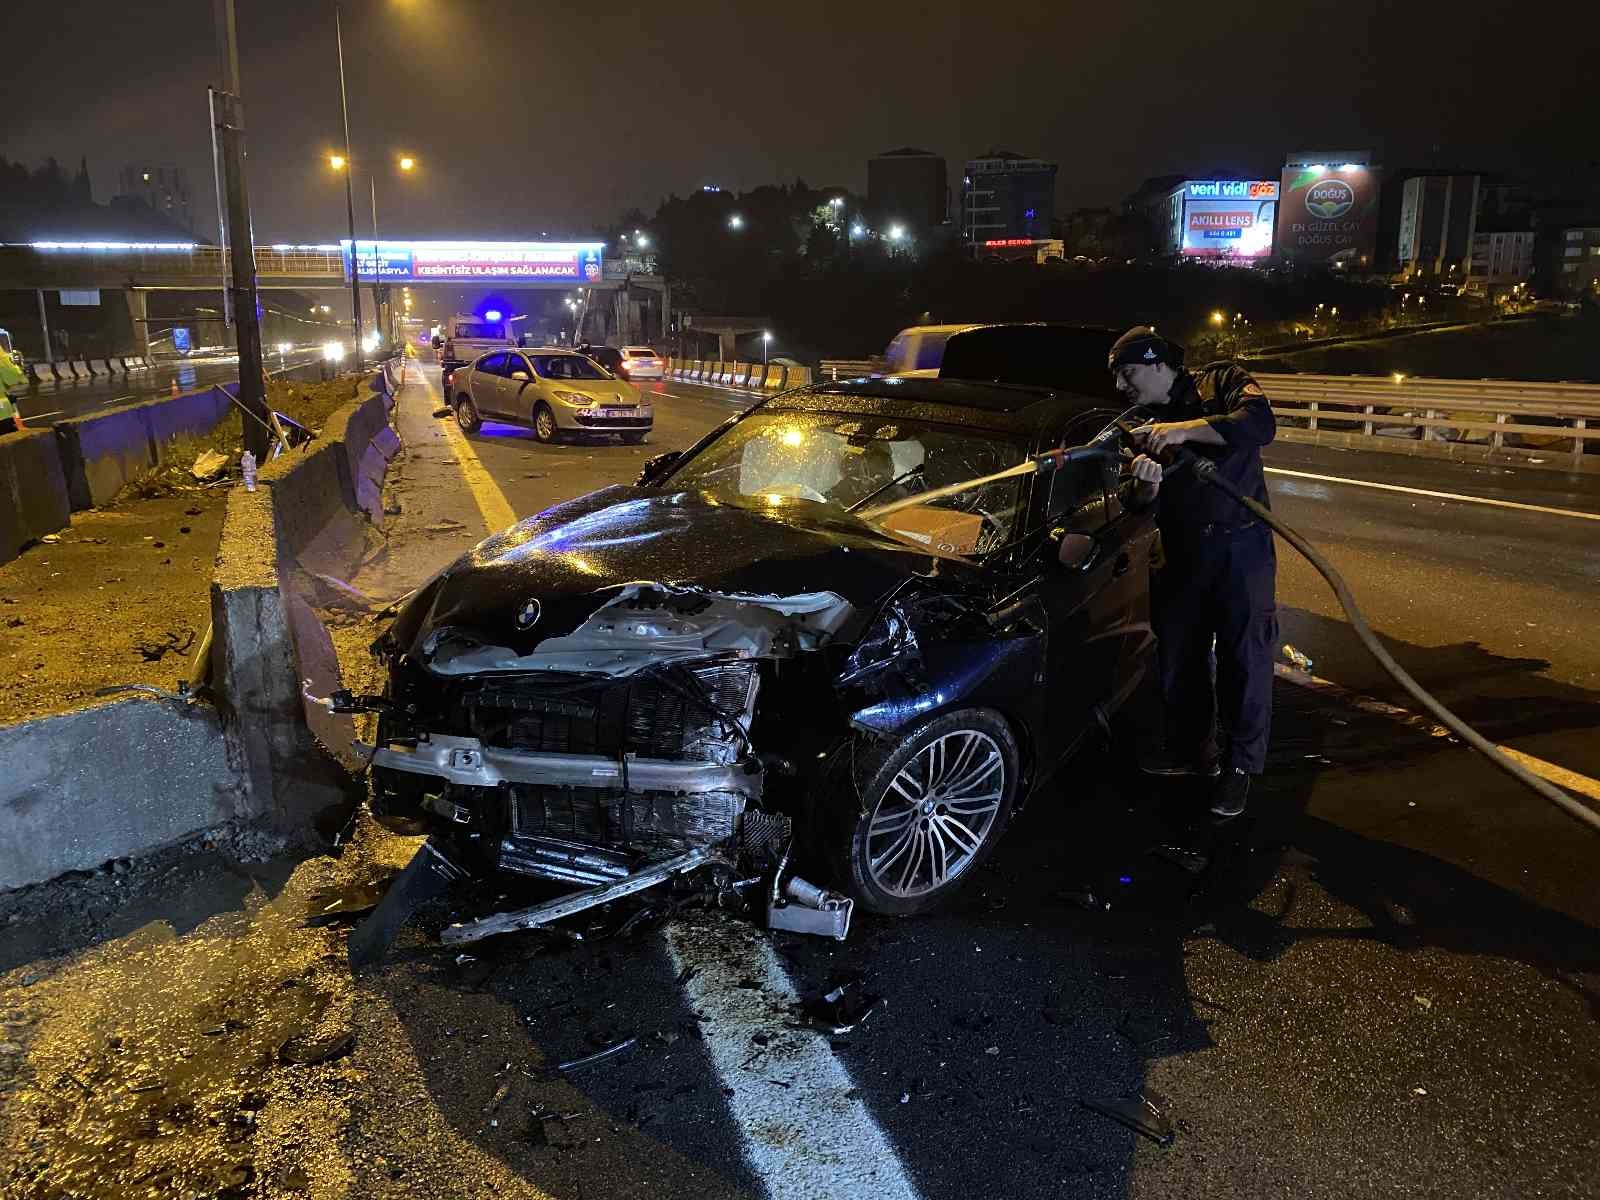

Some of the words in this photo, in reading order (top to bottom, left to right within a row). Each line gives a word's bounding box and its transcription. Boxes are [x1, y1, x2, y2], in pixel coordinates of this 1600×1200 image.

[1191, 182, 1219, 196] veni
[1223, 182, 1248, 196] vidi
[1249, 181, 1275, 199] göz
[1191, 215, 1223, 226] AKILLI
[1225, 215, 1250, 226] LENS
[511, 264, 576, 275] SAĞLANACAK
